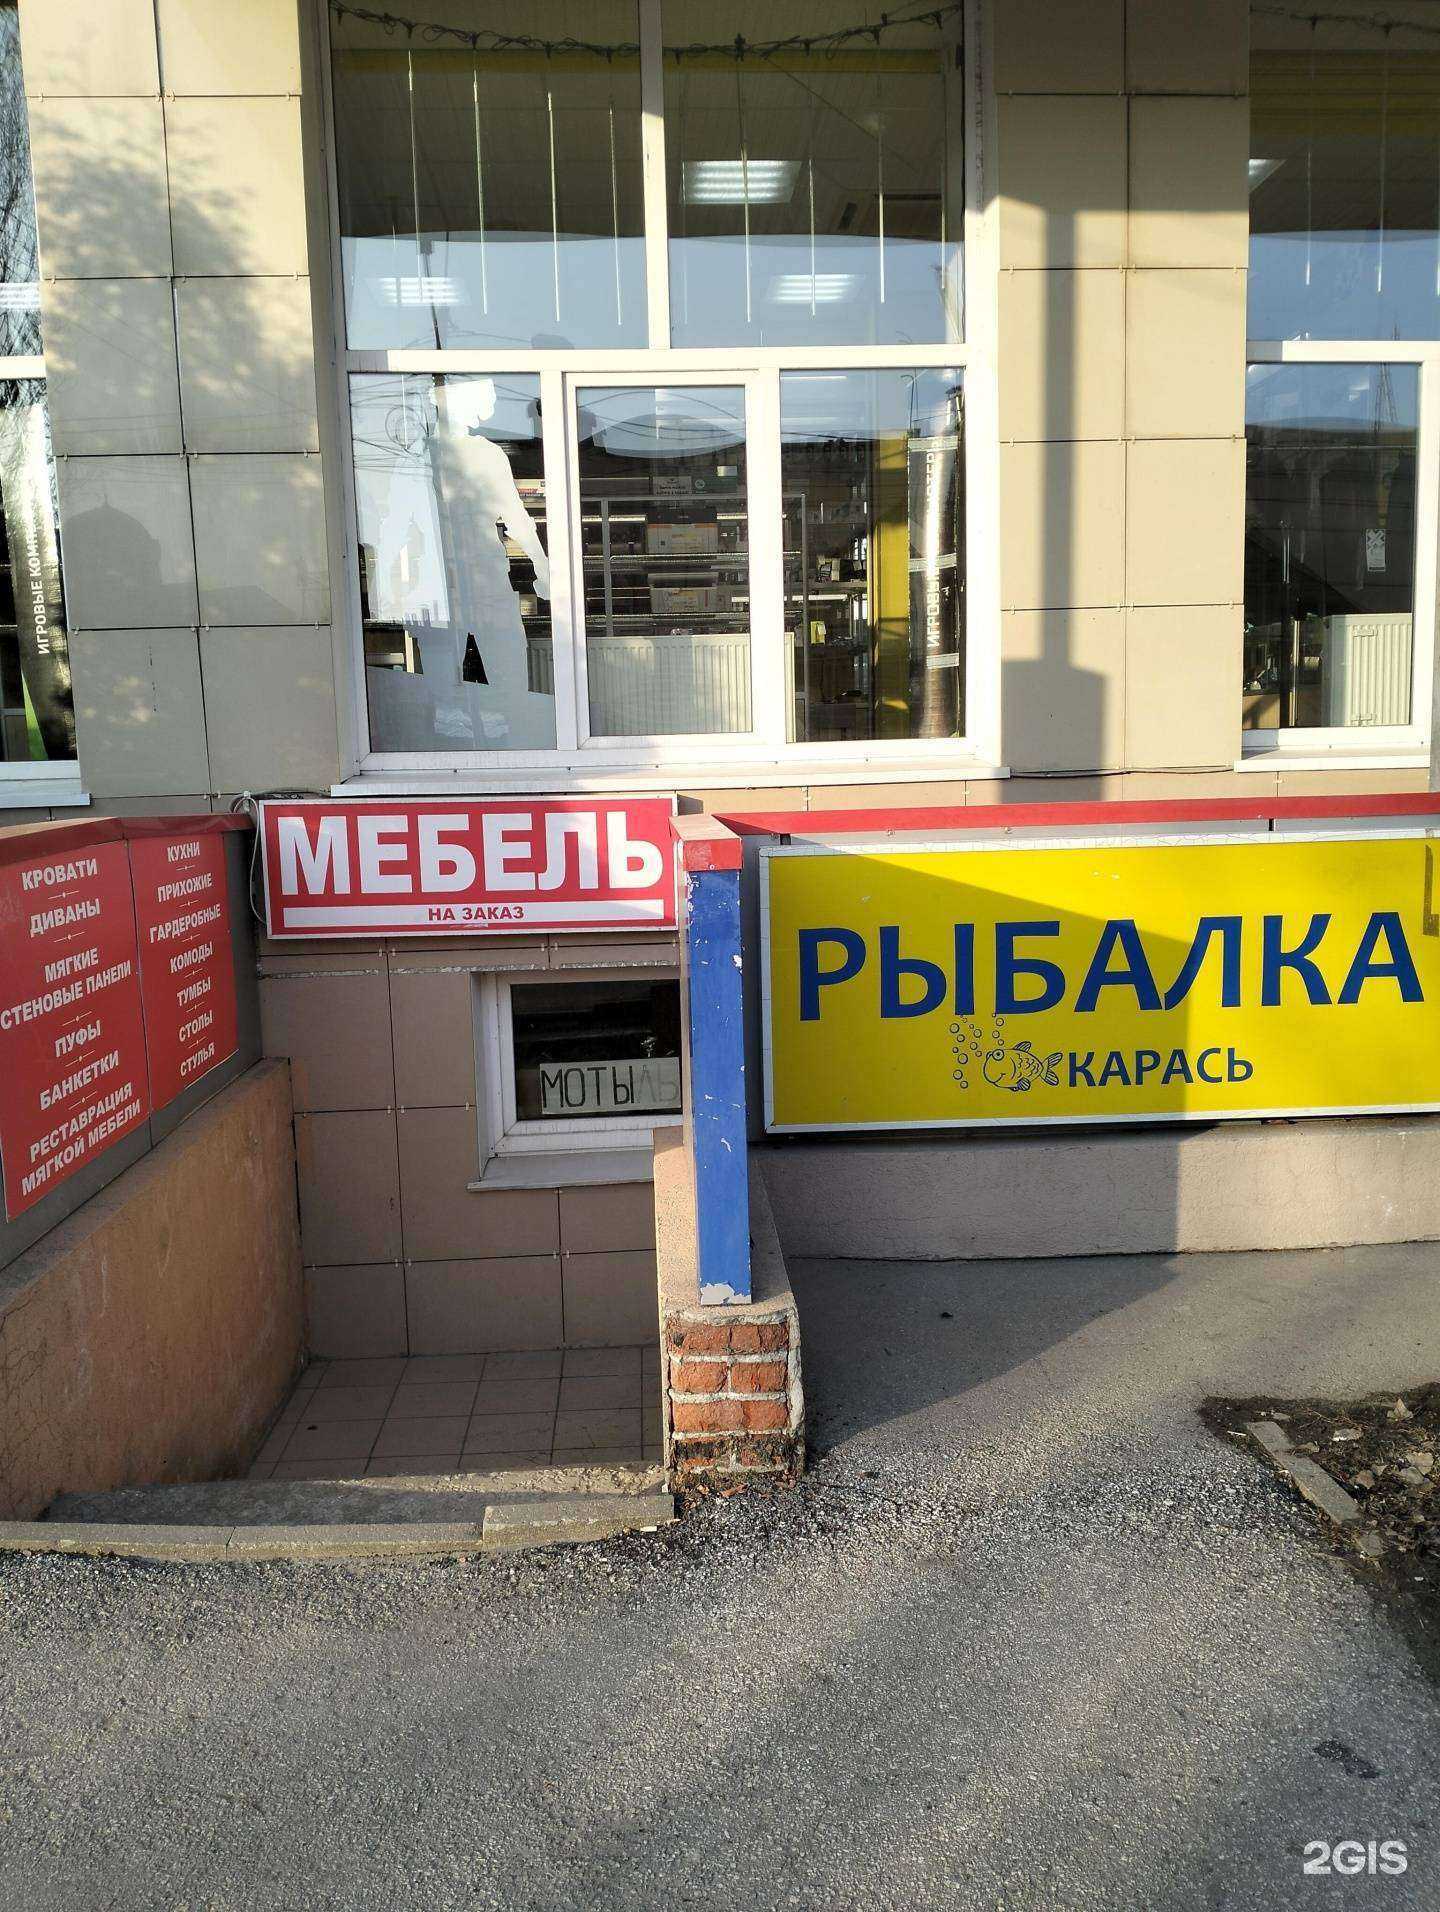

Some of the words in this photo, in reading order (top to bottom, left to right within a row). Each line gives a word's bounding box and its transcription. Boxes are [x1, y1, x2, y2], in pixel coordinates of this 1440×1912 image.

[30, 580, 49, 655] ИГРОВЫЕ
[167, 842, 200, 862] КУХНИ
[277, 811, 664, 895] МЕБЕЛЬ
[22, 858, 98, 890] КРОВАТИ
[157, 873, 212, 902] ПРИХОЖИЕ
[30, 898, 100, 938] ДИВАНЫ
[149, 904, 221, 943] ГАРДЕРОБНЫЕ
[428, 907, 455, 920] НА
[462, 906, 524, 920] ЗАКАЗ
[45, 948, 99, 983] МЯГКИЕ
[170, 941, 213, 973] КОМОДЫ
[798, 912, 1425, 1021] РЫБАЛКА
[1, 980, 83, 1030] СТЕНОВЫЕ
[86, 960, 131, 994] ПАНЕЛИ
[177, 976, 211, 1006] ТУМБЫ
[55, 1019, 101, 1057] ПУФЫ
[179, 1010, 213, 1042] СТОЛЫ
[180, 1042, 215, 1076] СТУЛЬЯ
[1068, 1047, 1254, 1088] КАРАСЬ
[40, 1050, 119, 1110] БАНКЕТКИ
[30, 1082, 133, 1163] РЕСТАВРАЦИЯ
[22, 1136, 85, 1196] МЯГКОЙ
[88, 1099, 141, 1148] МЕБЕЛИ
